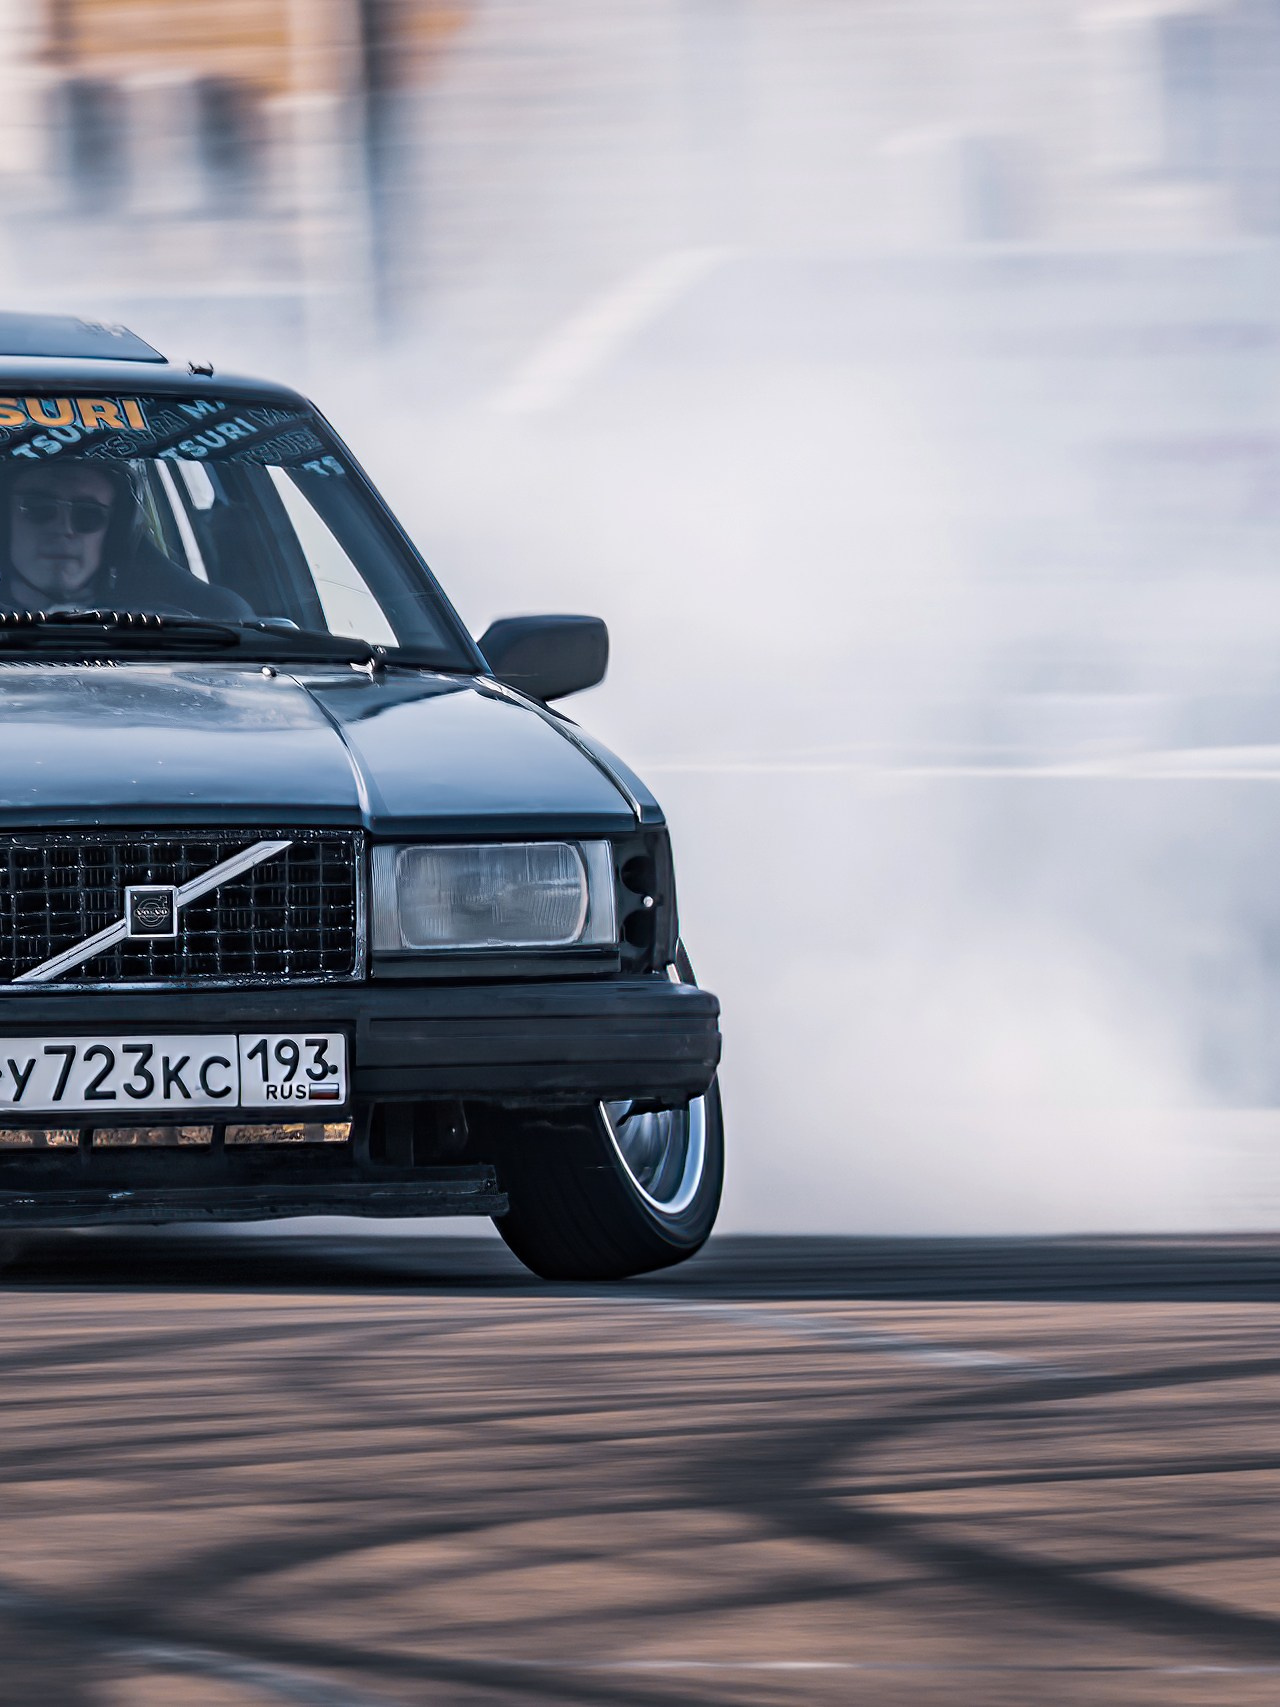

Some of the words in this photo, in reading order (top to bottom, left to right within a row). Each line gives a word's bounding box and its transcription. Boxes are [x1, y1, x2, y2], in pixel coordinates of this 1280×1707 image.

[158, 417, 259, 460] TSURI
[246, 1037, 331, 1083] 193
[265, 1083, 307, 1100] RUS
